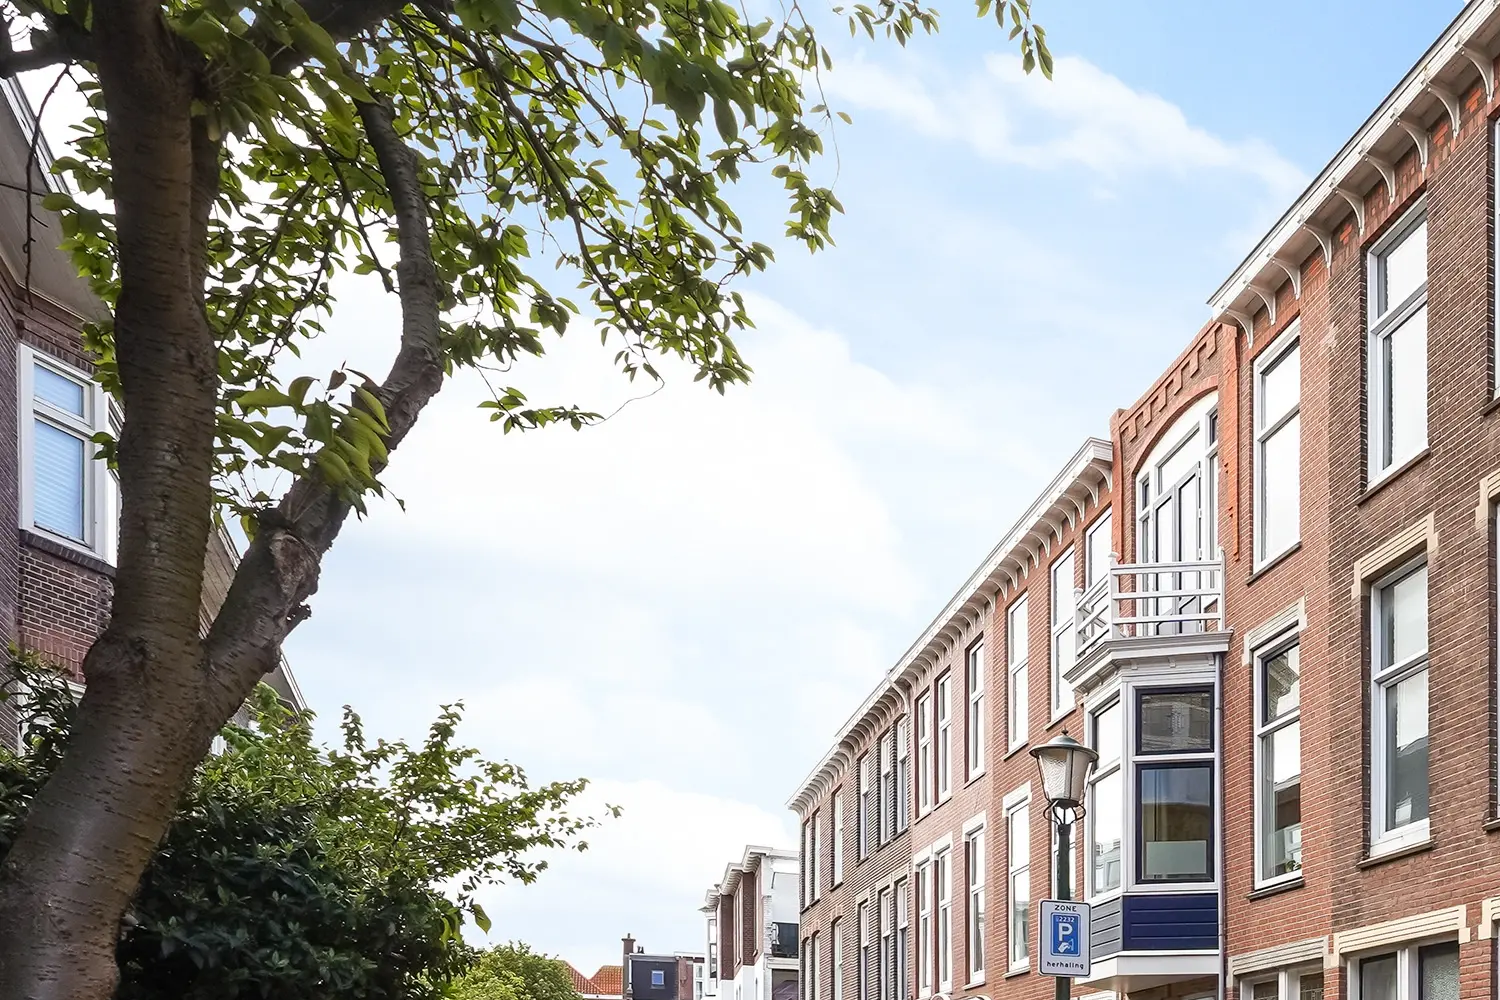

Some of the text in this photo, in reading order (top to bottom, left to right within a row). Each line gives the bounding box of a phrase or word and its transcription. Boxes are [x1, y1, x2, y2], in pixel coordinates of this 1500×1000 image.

[1054, 904, 1077, 912] ZONE
[1058, 923, 1073, 941] P
[1046, 961, 1084, 969] herhaling
